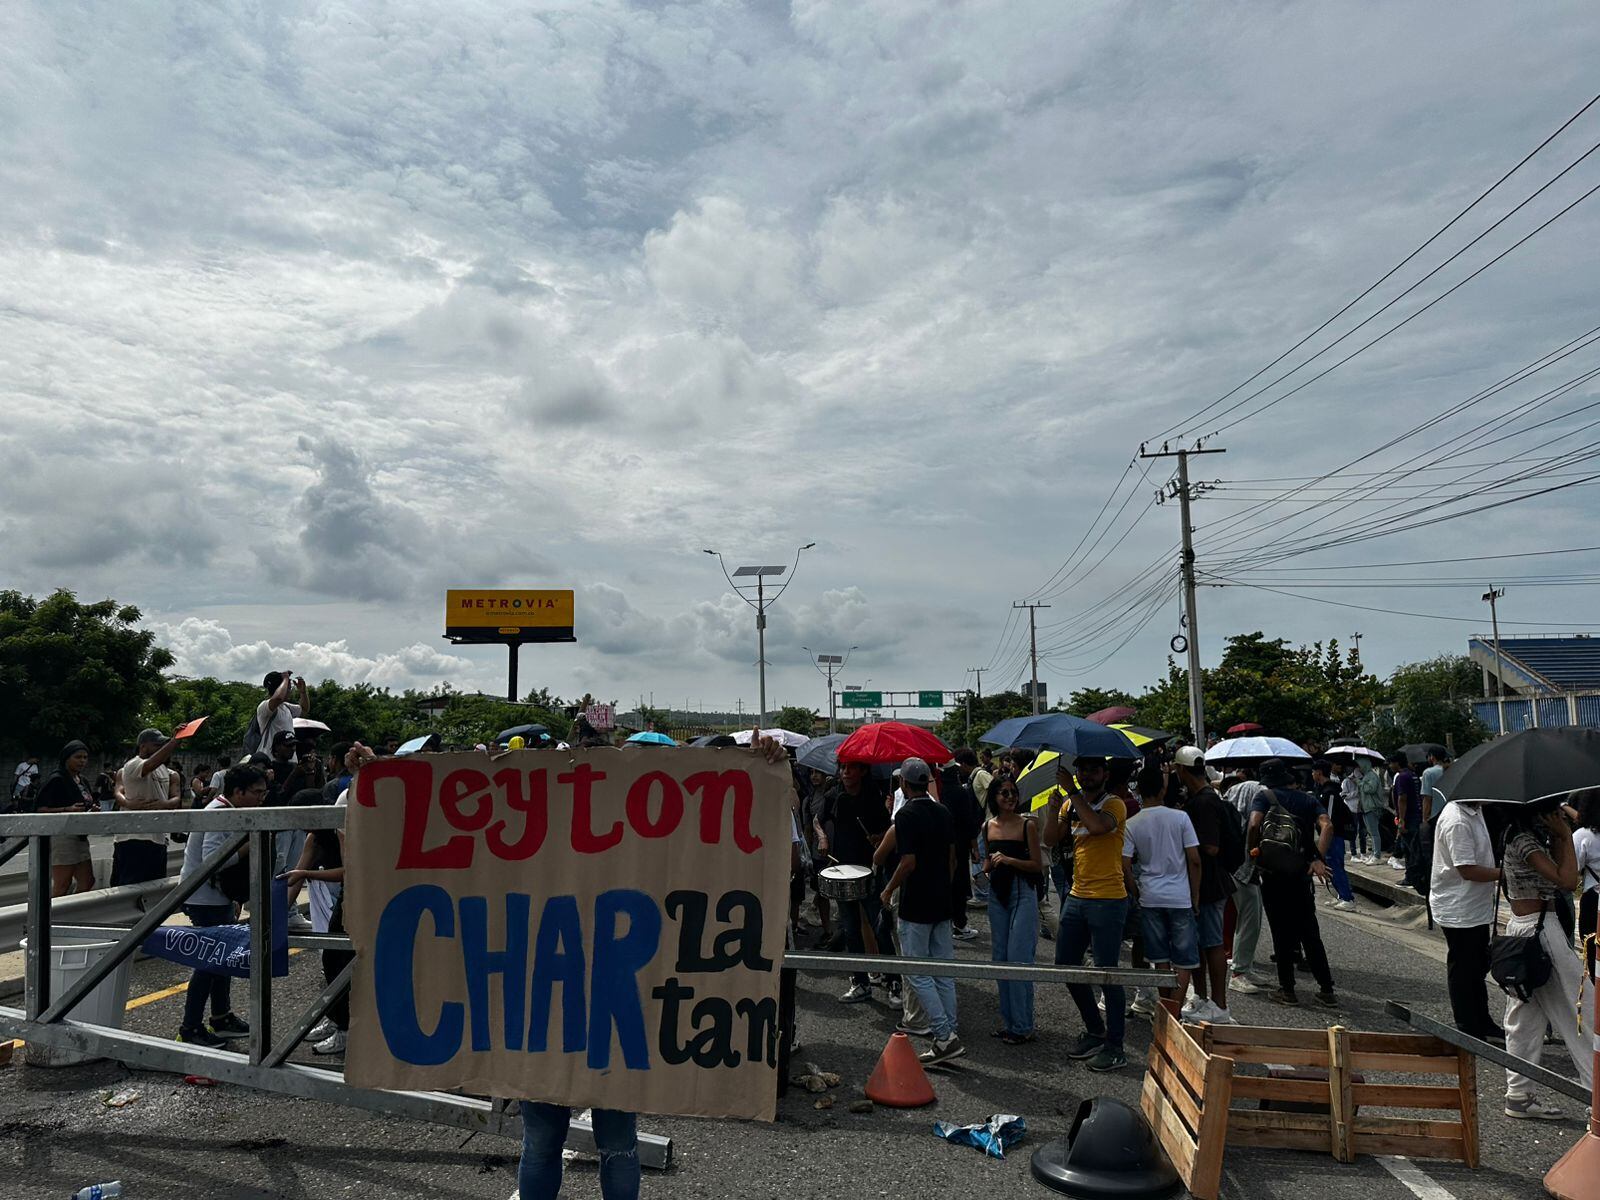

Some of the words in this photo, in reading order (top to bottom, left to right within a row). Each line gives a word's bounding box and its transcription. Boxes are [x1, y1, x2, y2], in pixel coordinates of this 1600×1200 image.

[357, 759, 763, 869] Leyton
[166, 929, 226, 965] VOTA
[374, 884, 662, 1071] CHAR
[652, 978, 776, 1069] tan
